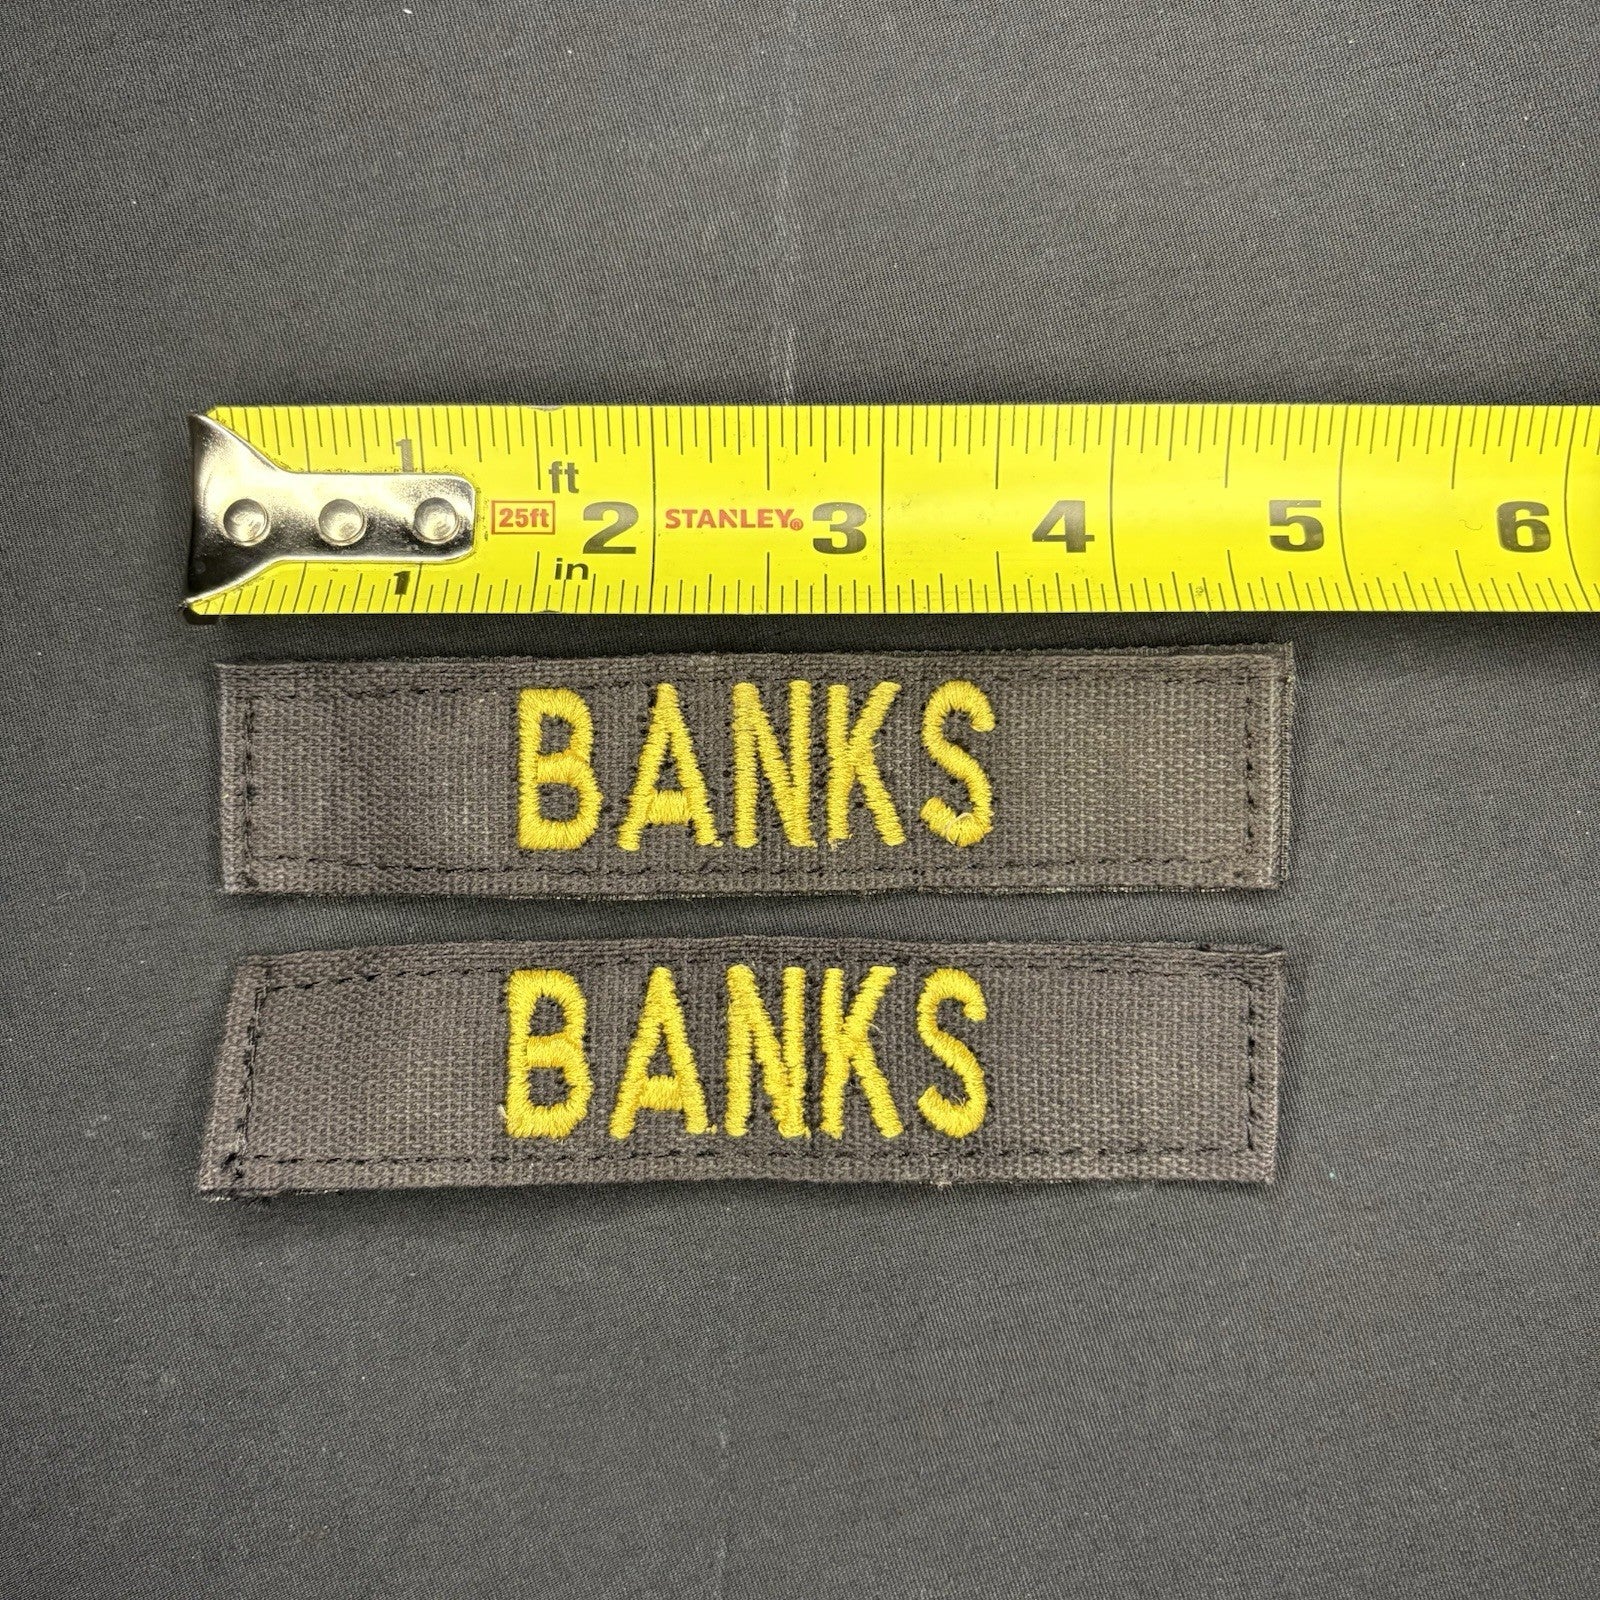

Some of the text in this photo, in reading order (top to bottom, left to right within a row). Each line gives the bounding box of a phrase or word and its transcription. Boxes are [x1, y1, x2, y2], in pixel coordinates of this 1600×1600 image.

[395, 439, 414, 472] 1
[549, 462, 579, 494] ft
[498, 508, 550, 529] 25ft
[582, 502, 639, 554] 2
[812, 502, 867, 555] 3
[1032, 500, 1095, 553] 4
[1269, 499, 1324, 552] 5
[1496, 501, 1551, 553] 6
[393, 571, 410, 595] 1
[554, 557, 589, 581] in
[518, 680, 996, 851] BANKS
[505, 964, 987, 1139] BANKS
